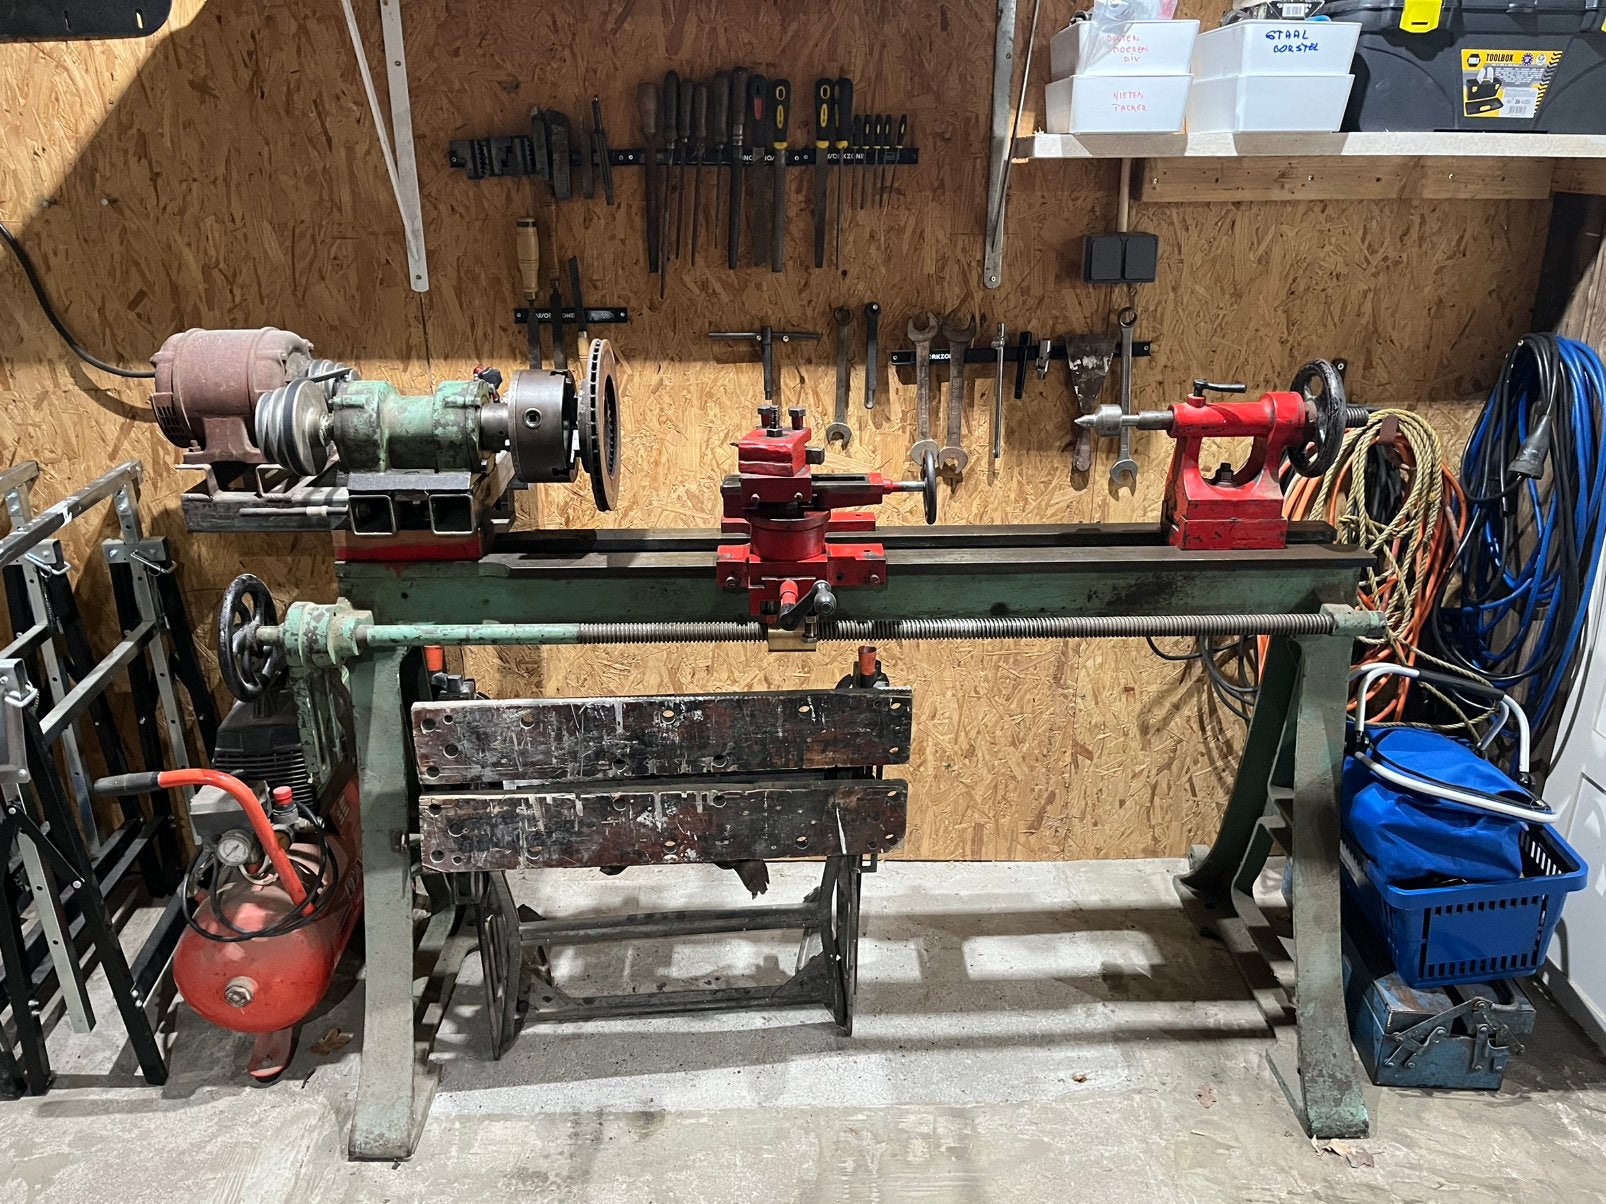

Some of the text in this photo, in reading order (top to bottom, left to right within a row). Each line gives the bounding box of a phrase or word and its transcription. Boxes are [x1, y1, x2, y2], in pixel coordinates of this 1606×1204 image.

[1265, 29, 1309, 40] STAAL
[1486, 54, 1514, 62] TOOLBOX
[1113, 91, 1144, 100] NIETEN
[1112, 103, 1147, 112] TACKER
